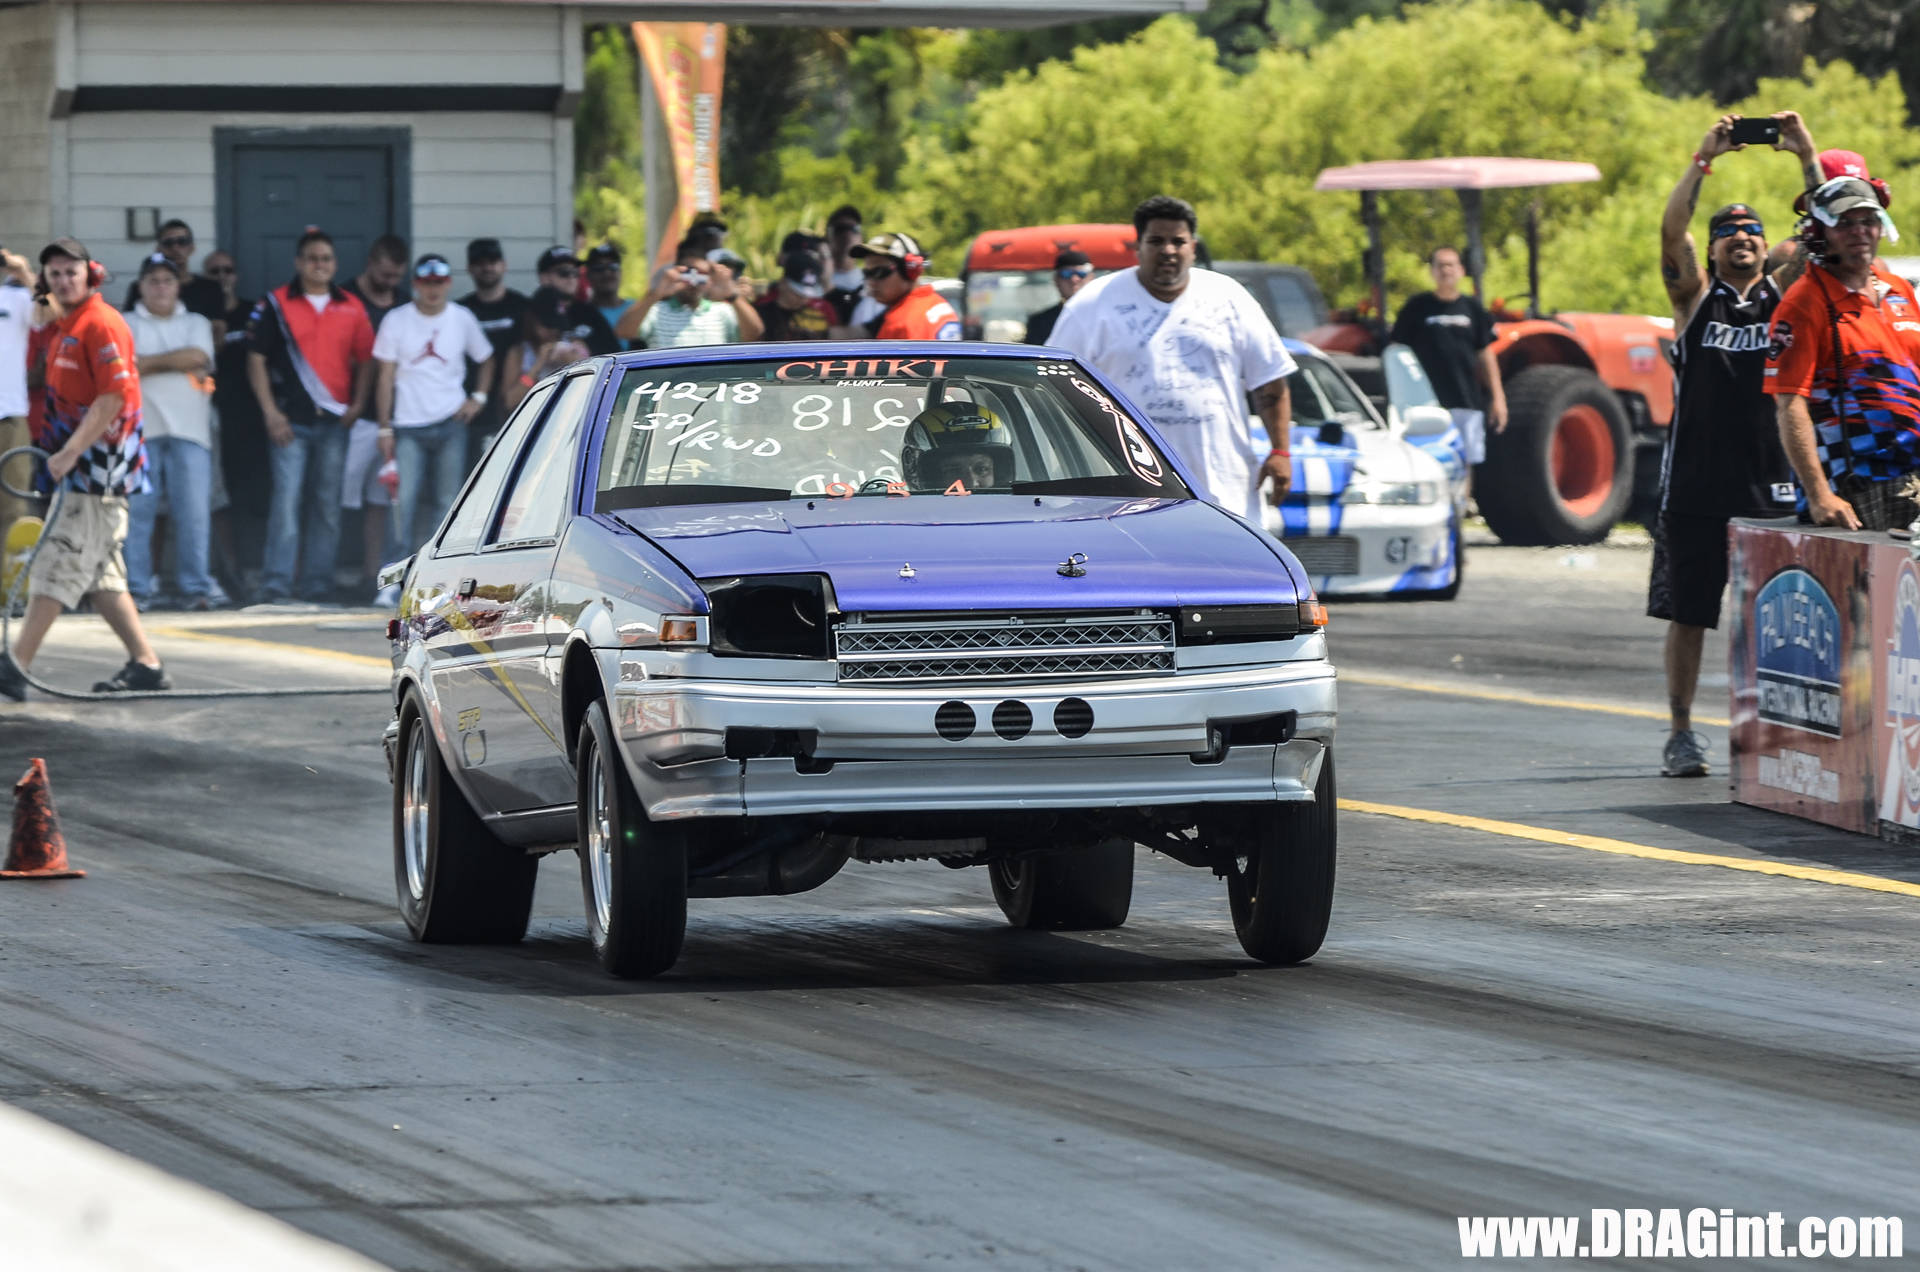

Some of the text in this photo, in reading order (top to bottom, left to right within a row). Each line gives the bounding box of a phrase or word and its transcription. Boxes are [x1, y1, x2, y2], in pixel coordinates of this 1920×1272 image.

[1702, 322, 1771, 351] MIAM
[776, 359, 949, 381] CHIKI
[634, 381, 762, 405] 4218
[458, 706, 481, 732] STP
